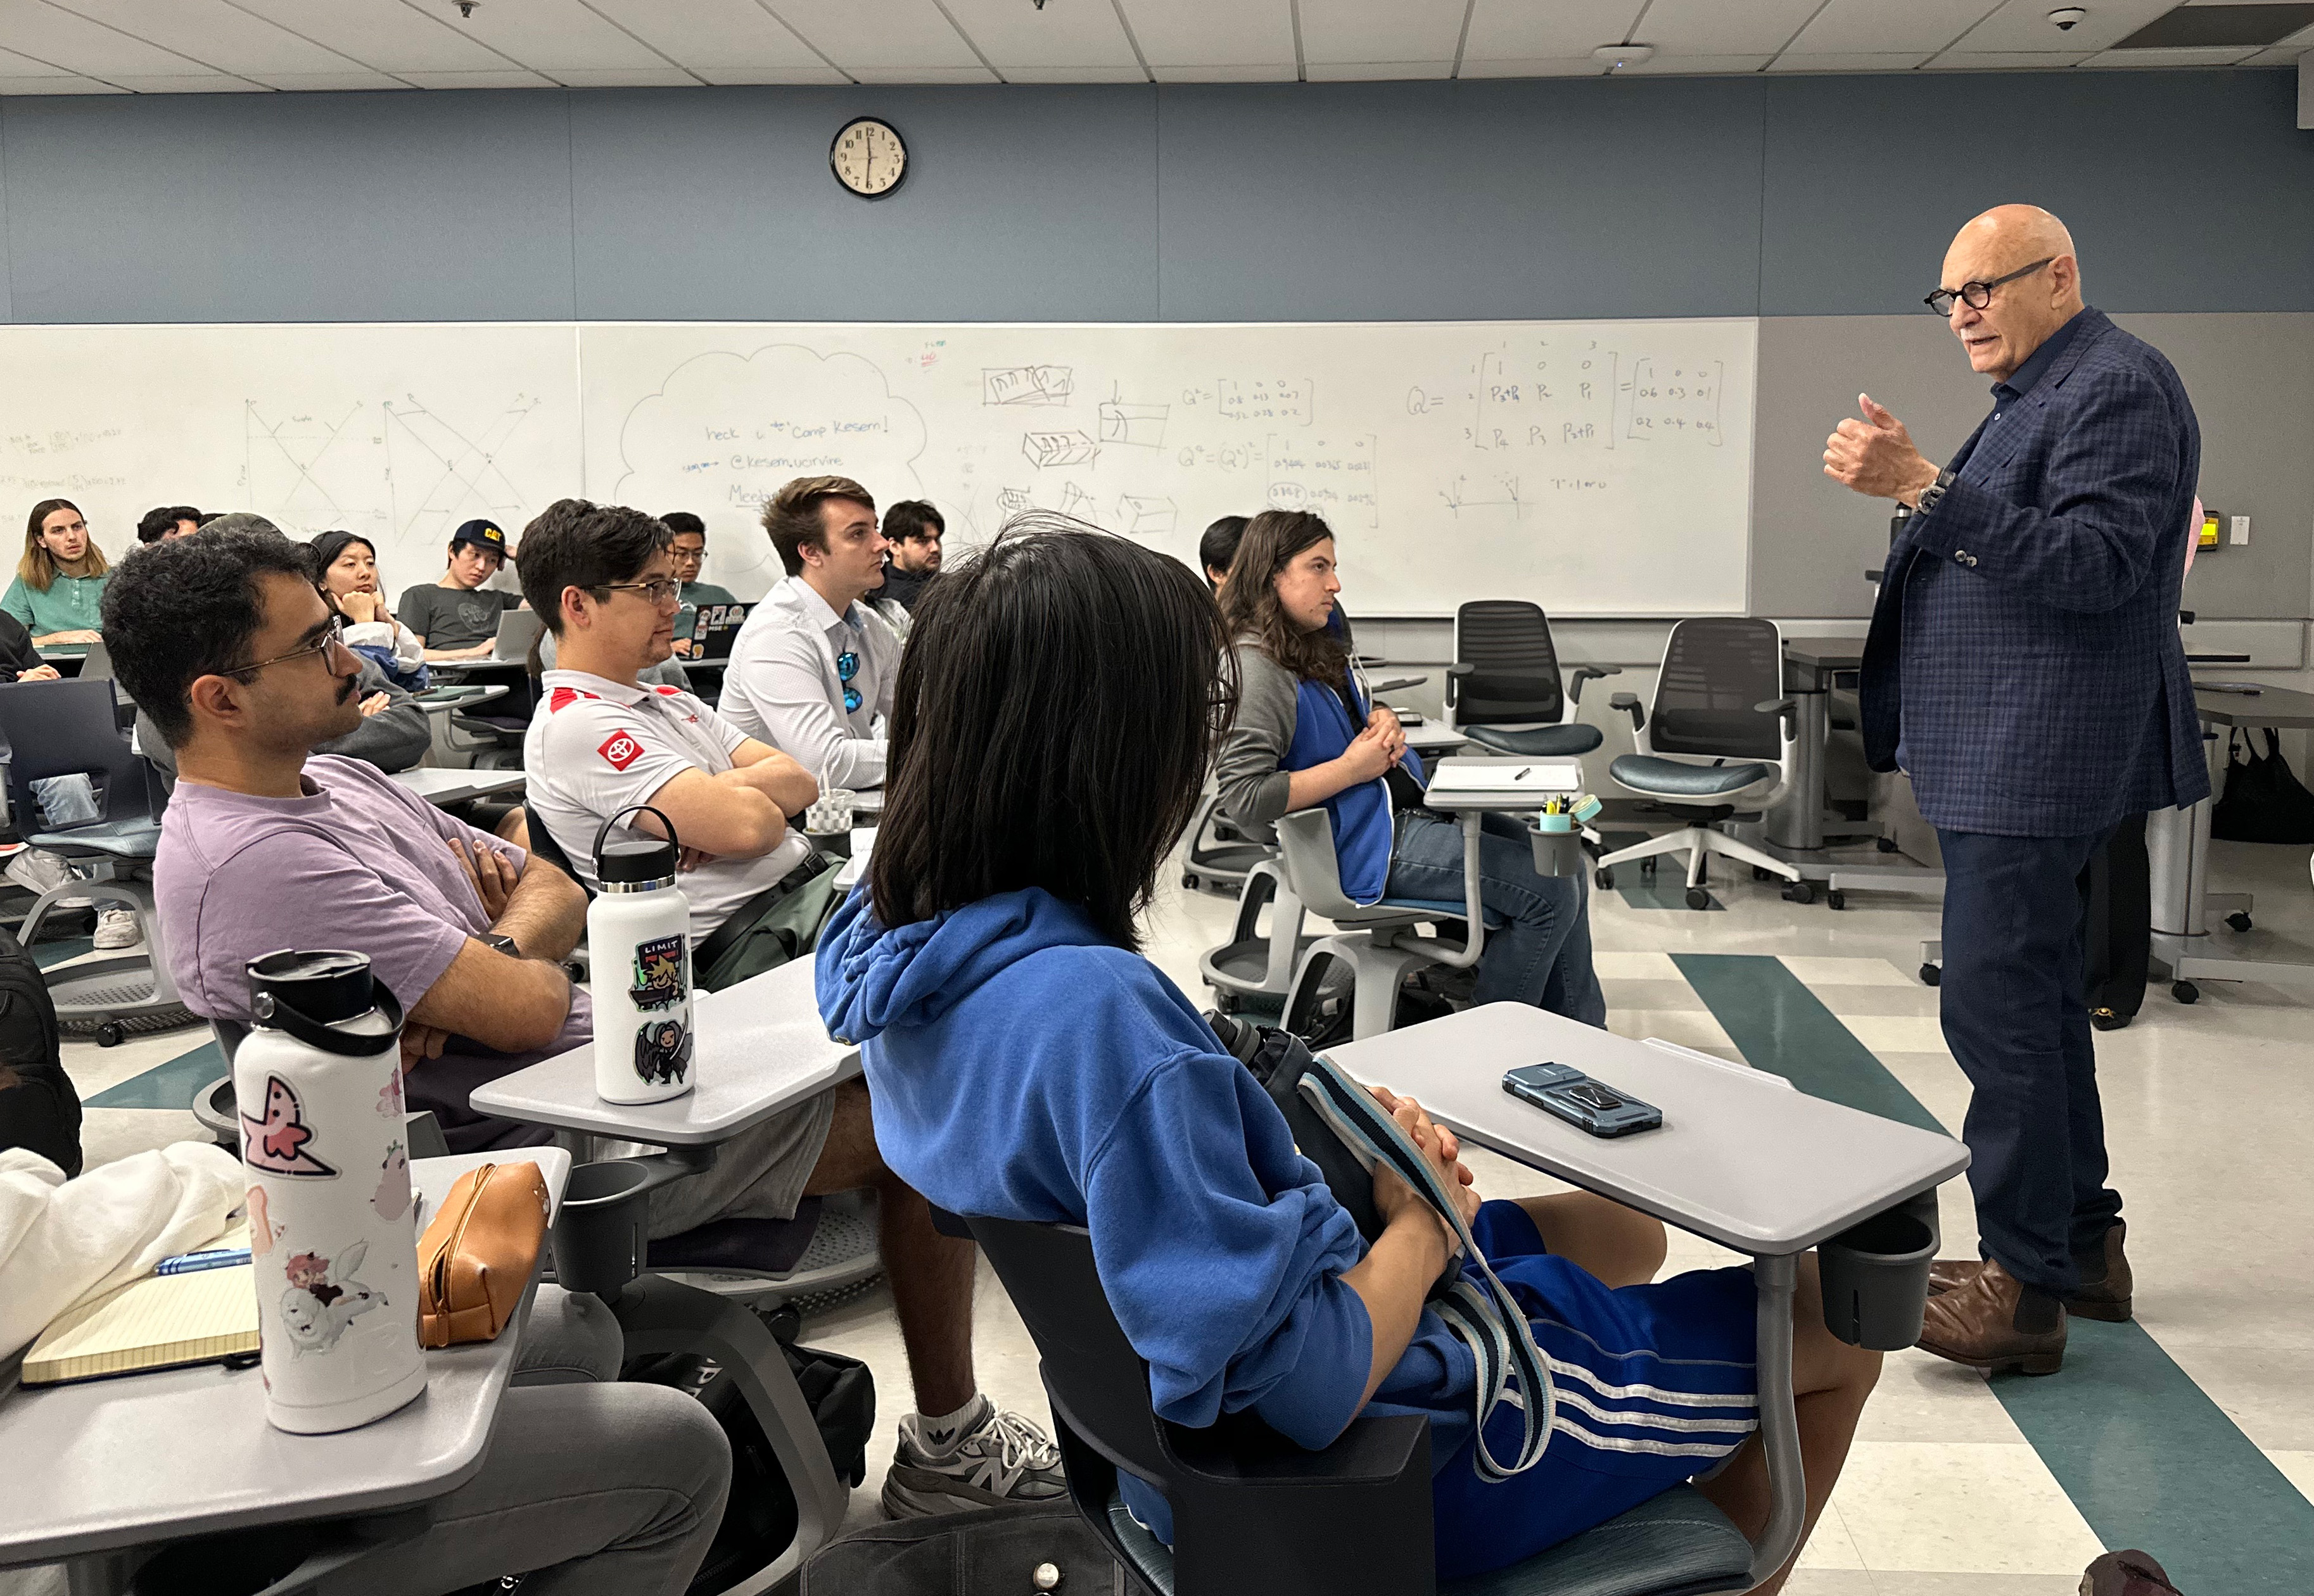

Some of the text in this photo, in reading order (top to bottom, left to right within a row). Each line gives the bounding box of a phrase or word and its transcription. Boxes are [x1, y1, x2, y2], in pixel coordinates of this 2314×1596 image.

[856, 130, 861, 139] 11
[866, 127, 875, 137] 12
[882, 131, 885, 141] 1
[845, 139, 854, 149] 10
[890, 141, 896, 151] 2
[840, 153, 847, 162] 9
[894, 155, 900, 164] 3
[844, 166, 851, 175] 8
[889, 167, 895, 177] 4
[854, 177, 860, 186] 7
[867, 180, 873, 190] 6
[879, 178, 886, 187] 5
[792, 426, 827, 439] Camp
[485, 528, 502, 542] CAT
[645, 940, 678, 954] LIMIT
